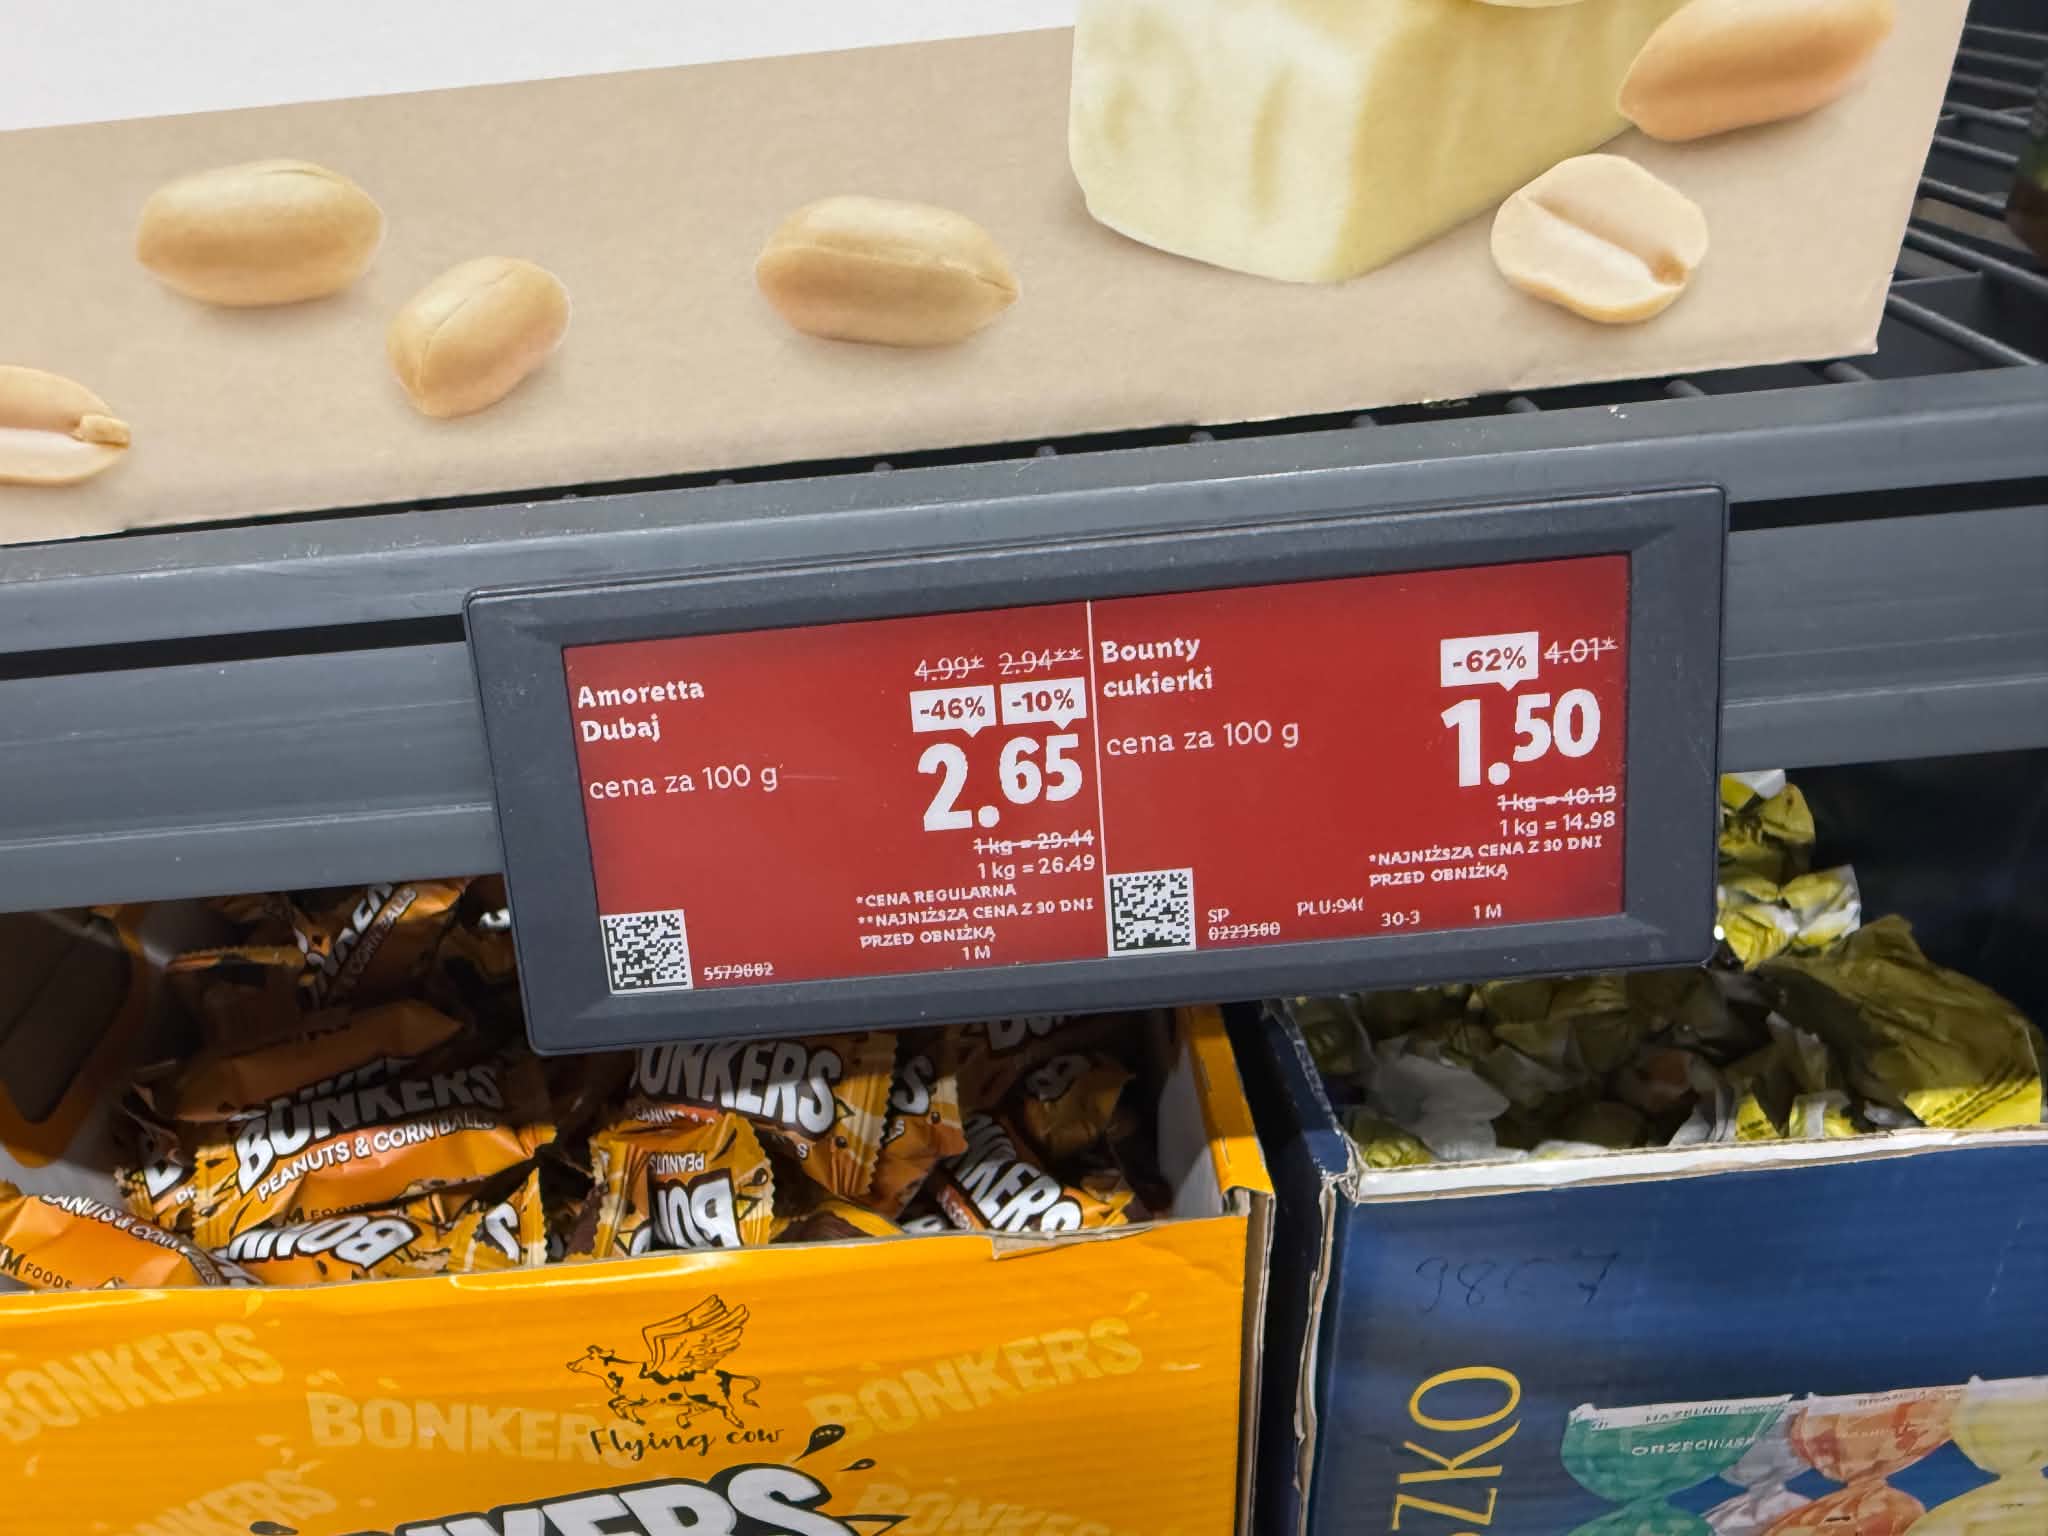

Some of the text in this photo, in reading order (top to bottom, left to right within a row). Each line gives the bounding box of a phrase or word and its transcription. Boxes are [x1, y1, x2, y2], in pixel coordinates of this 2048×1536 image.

[1101, 637, 1201, 664] Bounty
[1452, 644, 1527, 673] -62%
[577, 679, 705, 709] Amoretta
[1103, 666, 1214, 698] cukierki
[920, 695, 986, 721] -46%
[1011, 688, 1075, 713] -10%
[580, 713, 661, 744] Dubaj
[1106, 719, 1300, 756] cena za 100 g
[1440, 688, 1601, 788] 1.50
[589, 763, 779, 800] cena za 100 g
[917, 733, 1083, 831] 2.65
[1564, 785, 1617, 805] 40.13
[1499, 819, 1508, 837] 1
[1514, 817, 1538, 837] kg
[1562, 810, 1616, 831] 14.98
[1037, 829, 1095, 850] 29.44
[1478, 840, 1525, 857] CENA
[1527, 840, 1540, 854] Z
[1543, 838, 1563, 852] 30
[1567, 835, 1603, 850] DNI
[978, 862, 986, 879] 1
[992, 861, 1016, 881] kg
[1038, 854, 1096, 875] 26.49
[1368, 861, 1509, 887] PRZED OBNIŻKĄ
[914, 883, 1017, 904] REGULARNA
[972, 903, 1017, 921] CENA
[1021, 902, 1033, 916] Z
[1060, 897, 1094, 913] DNI
[1207, 908, 1231, 924] SP
[1381, 909, 1421, 928] 30-3
[860, 923, 996, 949] PRZED OBNIŻKĄ
[257, 1140, 350, 1202] PEANUTS
[354, 1137, 372, 1159] &
[373, 1120, 435, 1153] CORN
[804, 1316, 1146, 1444] BONKERS
[304, 1390, 643, 1470] BONKERS
[590, 1427, 784, 1462] Flying cow
[1391, 1366, 1521, 1536] ZKO
